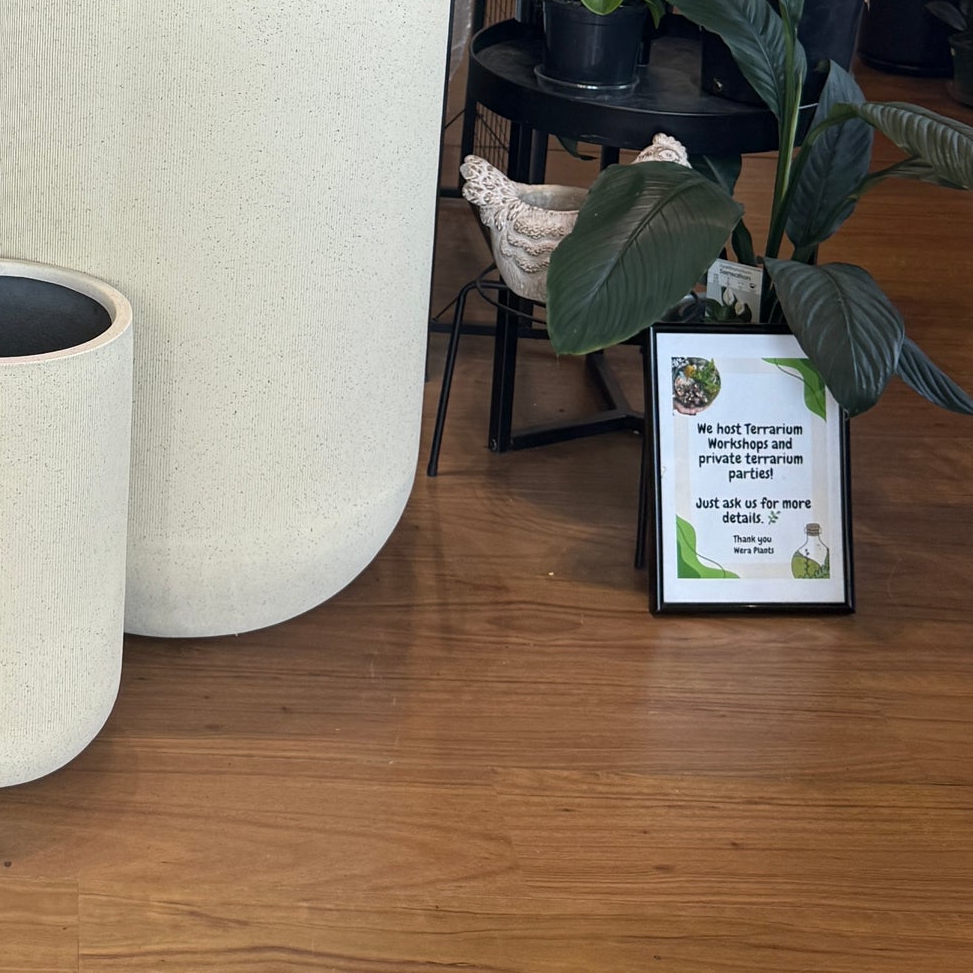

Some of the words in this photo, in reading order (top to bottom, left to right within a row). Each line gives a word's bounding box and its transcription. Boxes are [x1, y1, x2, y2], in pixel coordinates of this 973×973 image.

[697, 423, 713, 434] We
[716, 423, 742, 435] host
[744, 423, 803, 435] Terrarium
[708, 437, 769, 453] Workshops
[771, 437, 793, 449] and
[698, 452, 742, 467] private
[745, 452, 803, 464] terrarium
[728, 467, 774, 482] parties!
[696, 497, 720, 509] Just
[722, 497, 742, 508] ask
[744, 499, 758, 508] us
[760, 497, 780, 509] for
[782, 499, 812, 509] more
[722, 511, 764, 524] details.
[733, 535, 756, 543] Thank
[757, 536, 772, 545] you
[733, 546, 752, 554] Wera
[753, 546, 774, 554] Plants
